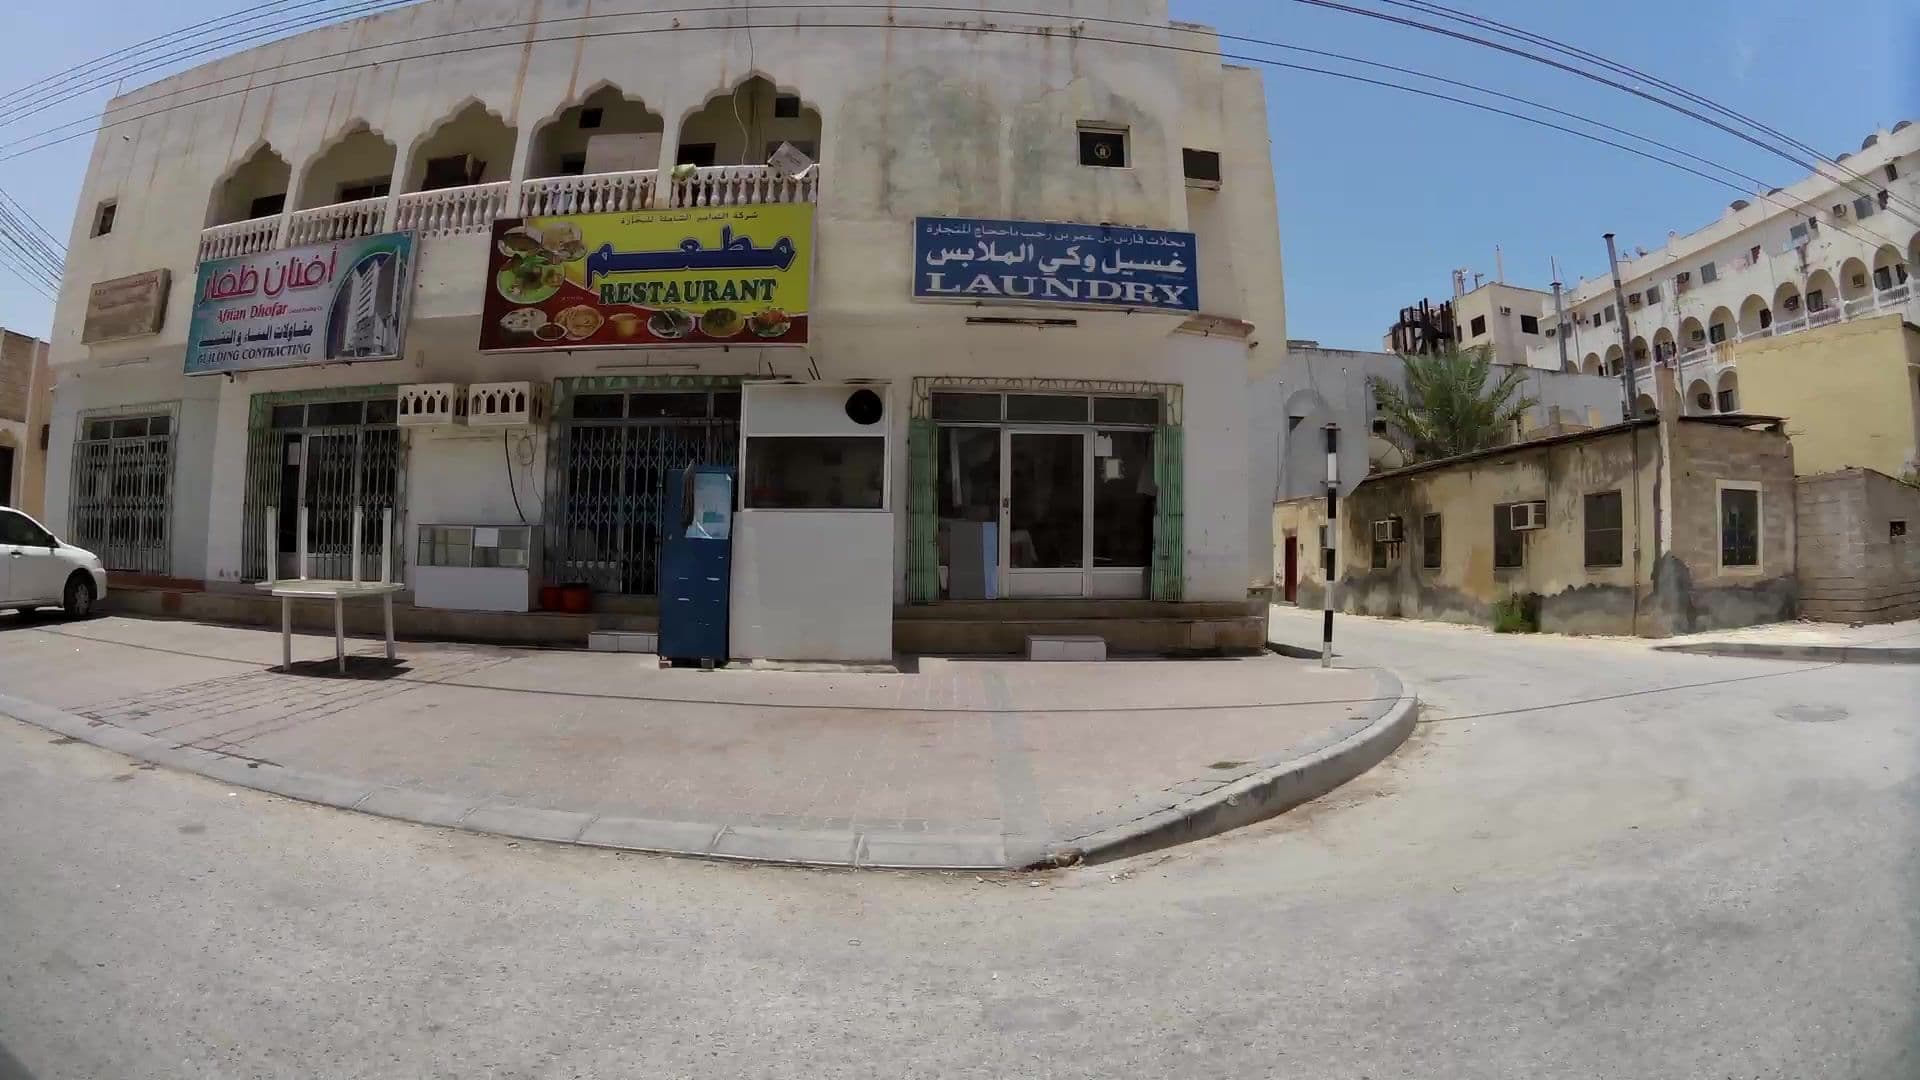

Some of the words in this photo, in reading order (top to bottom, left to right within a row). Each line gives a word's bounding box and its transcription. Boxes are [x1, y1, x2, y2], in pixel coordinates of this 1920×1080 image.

[733, 211, 759, 221] شركة
[926, 223, 971, 236] للتجارة
[926, 240, 1034, 268] الملابس
[1145, 236, 1186, 249] محلات
[586, 223, 797, 290] مطعم
[1101, 248, 1188, 276] غسيل
[263, 244, 338, 297] أفنان
[199, 264, 260, 305] ظفار
[600, 278, 778, 305] RESTAURANT
[925, 272, 1189, 305] LAUNDRY
[217, 307, 246, 324] Afnan
[250, 302, 289, 318] Dhofar
[274, 319, 314, 342] مقاولات
[242, 343, 312, 361] CONTRACTING
